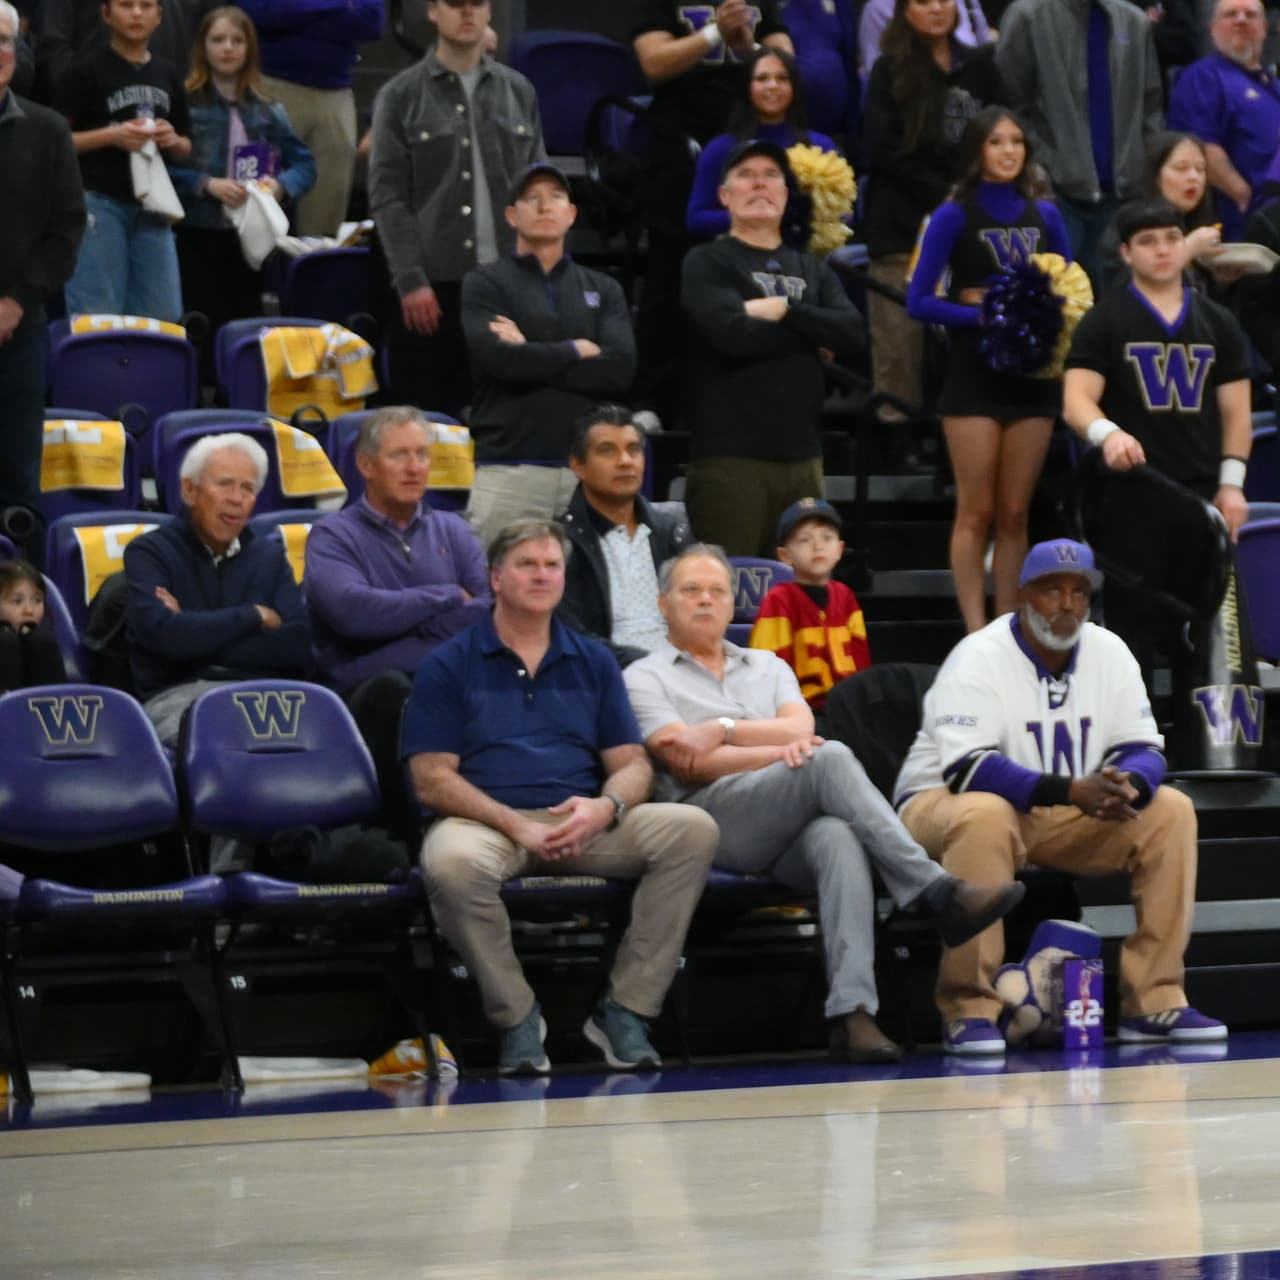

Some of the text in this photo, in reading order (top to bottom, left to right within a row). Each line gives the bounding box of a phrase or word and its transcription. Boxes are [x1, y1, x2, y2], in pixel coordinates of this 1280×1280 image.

[1125, 341, 1217, 414] W
[27, 696, 103, 745] W
[233, 691, 305, 738] W
[1192, 684, 1264, 746] W
[297, 883, 388, 898] WASHINGTON
[520, 876, 607, 890] WASHINGTON
[93, 889, 184, 905] WASHINGTON
[229, 975, 248, 991] 15
[18, 985, 36, 1000] 14
